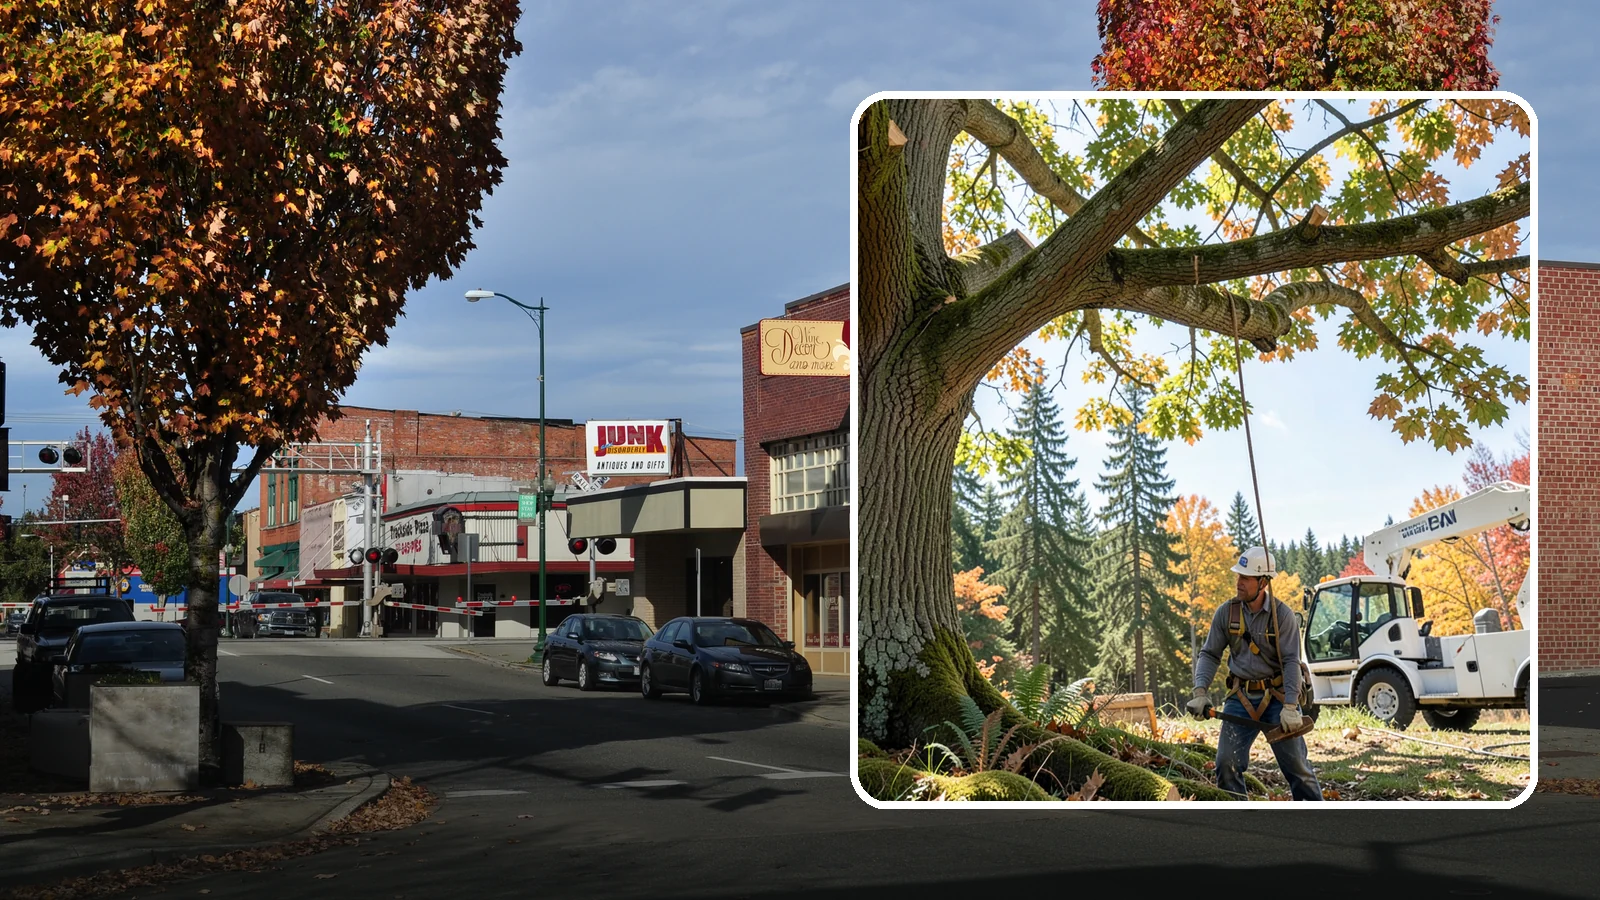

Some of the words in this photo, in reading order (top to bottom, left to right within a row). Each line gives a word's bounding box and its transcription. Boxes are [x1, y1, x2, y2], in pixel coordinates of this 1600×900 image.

[765, 328, 831, 365] Decor
[596, 425, 664, 457] JUNK
[607, 446, 646, 454] DISORDERLY
[597, 461, 627, 470] ANTIQUES
[631, 461, 643, 469] AND
[647, 461, 665, 469] GIFTS
